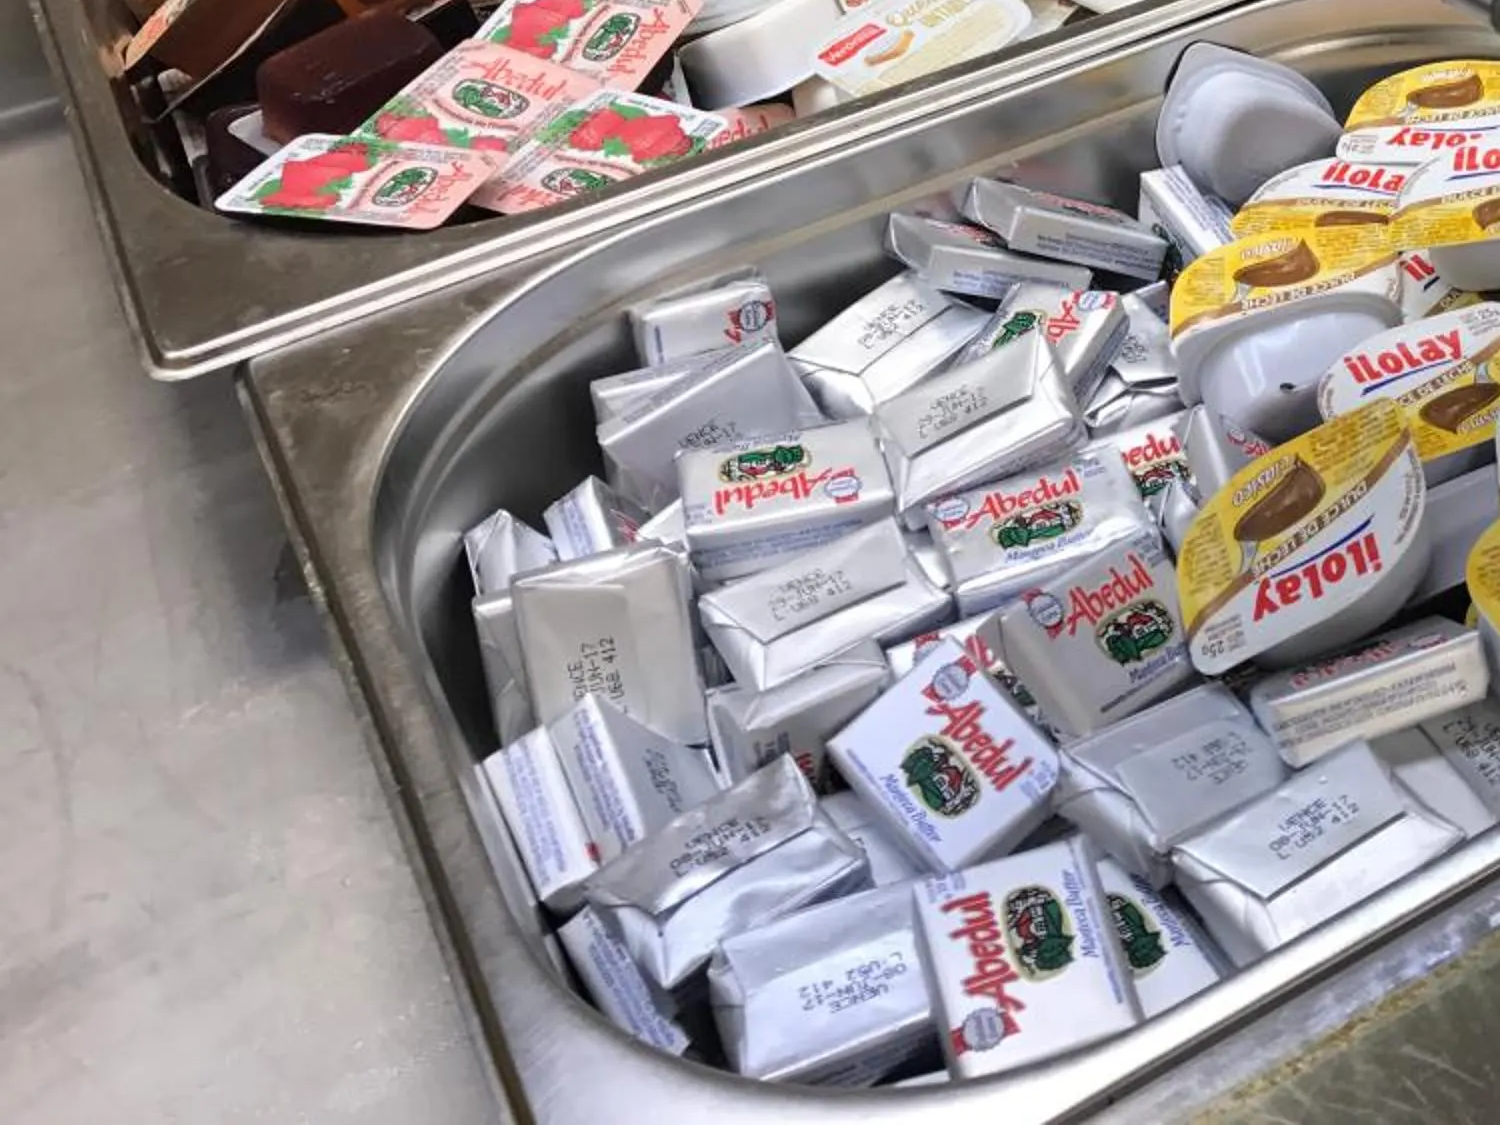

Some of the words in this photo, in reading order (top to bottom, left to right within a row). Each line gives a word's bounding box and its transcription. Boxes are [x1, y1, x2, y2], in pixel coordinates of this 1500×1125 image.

[713, 466, 833, 516] Abedul
[966, 466, 1082, 527] Abedul
[1065, 552, 1155, 636] Abedul
[924, 699, 1034, 792] Abedul
[939, 889, 1027, 1014] Abedul
